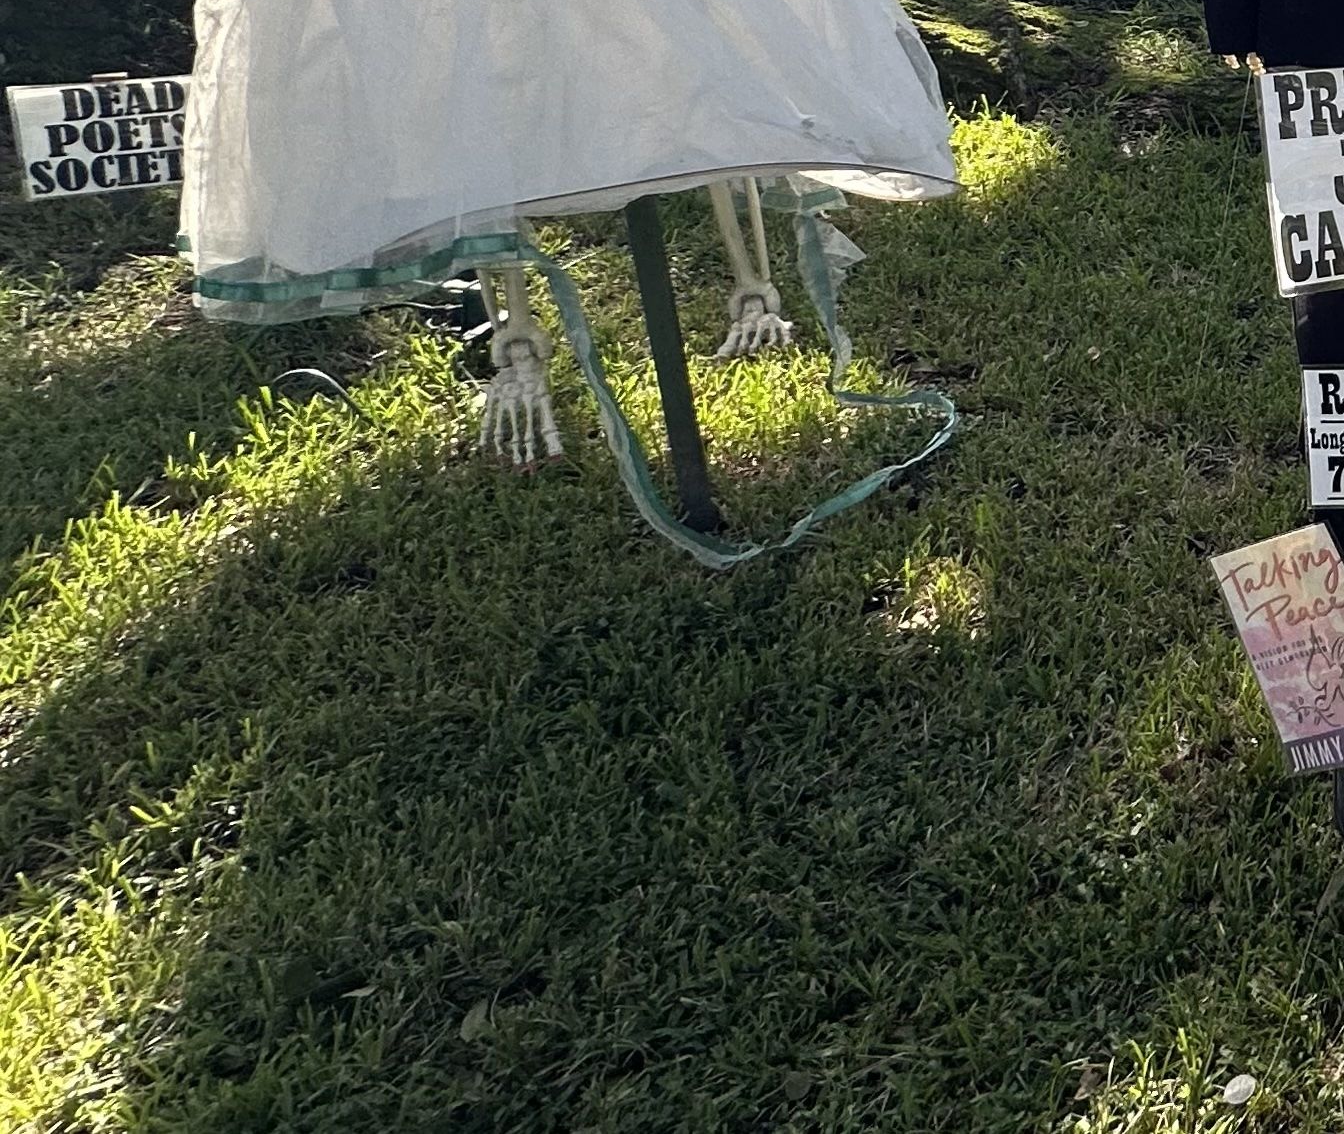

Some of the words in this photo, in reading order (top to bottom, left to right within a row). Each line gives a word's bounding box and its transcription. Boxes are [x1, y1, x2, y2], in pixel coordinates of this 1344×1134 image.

[60, 80, 185, 121] DEAD
[45, 113, 186, 157] POETS
[30, 149, 184, 194] SOCIET
[1220, 548, 1344, 612] Talking
[1290, 735, 1344, 773] JIMMY
